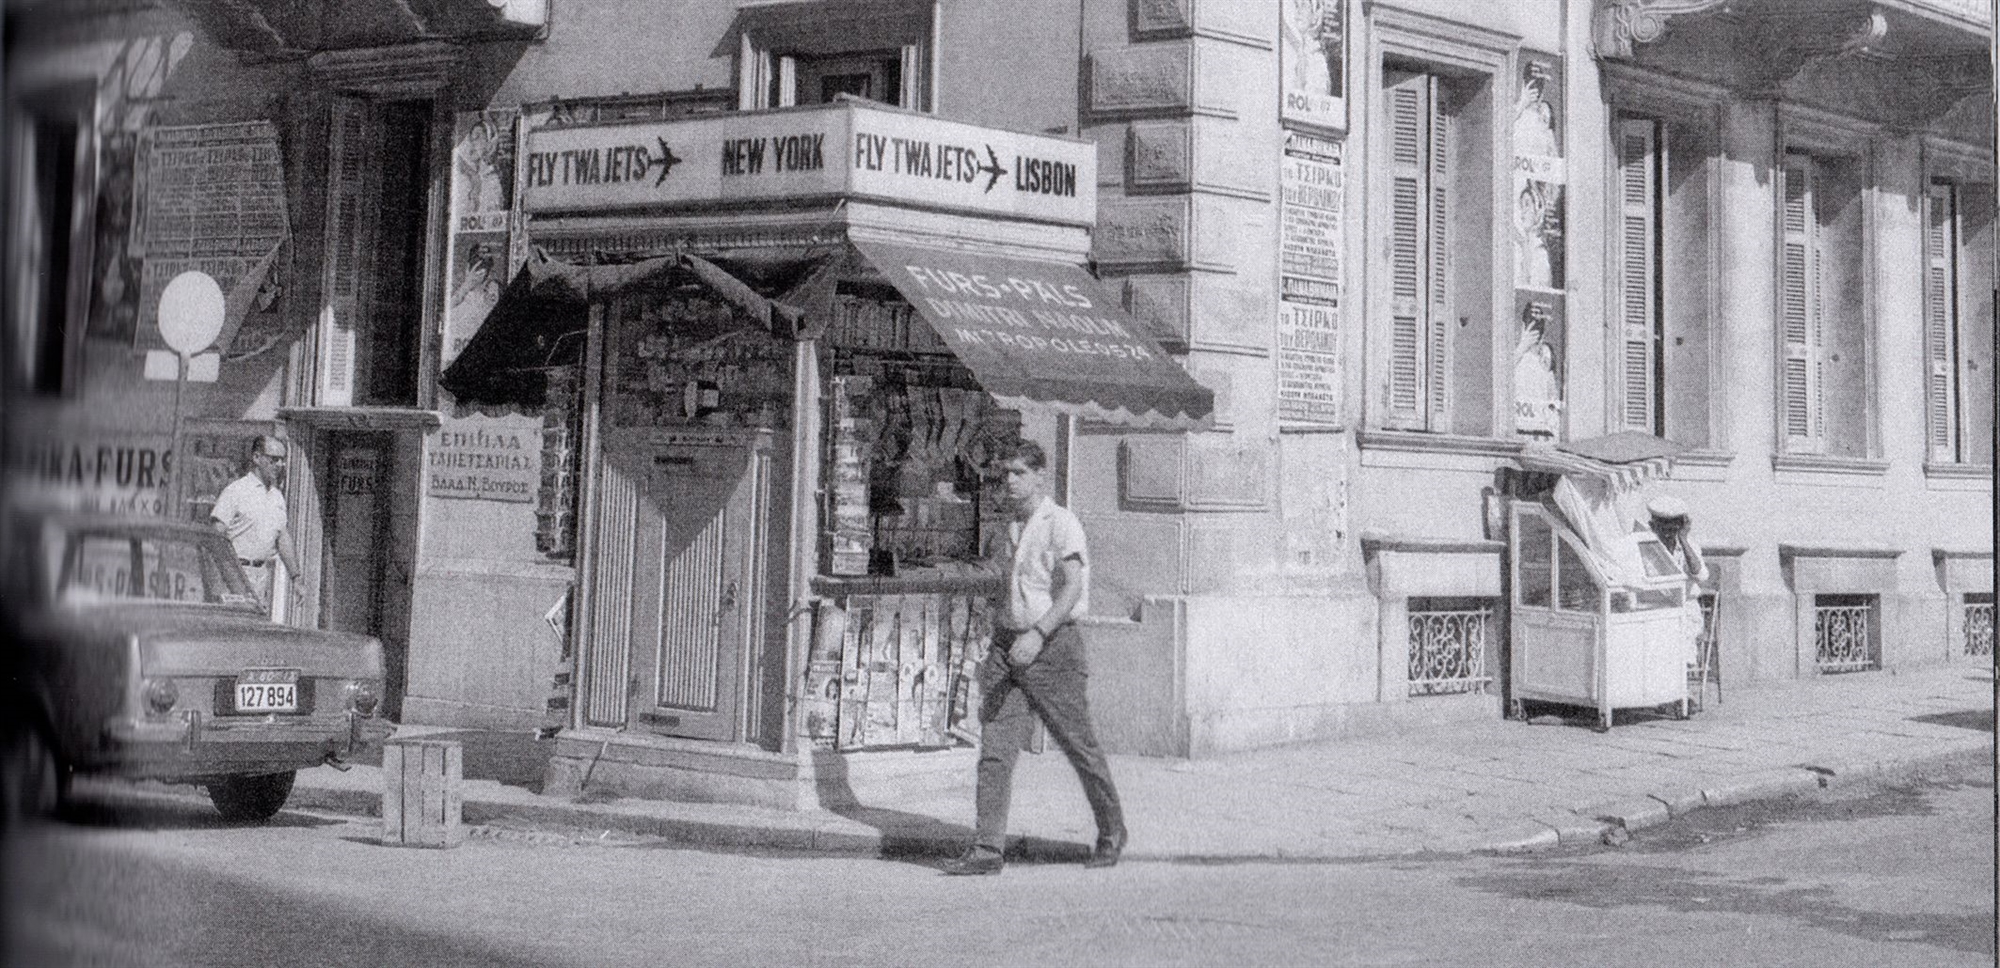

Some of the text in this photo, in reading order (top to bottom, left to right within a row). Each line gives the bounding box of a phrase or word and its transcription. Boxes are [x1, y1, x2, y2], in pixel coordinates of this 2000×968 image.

[527, 132, 825, 188] FLY TWA JETS NEW YORK
[855, 132, 1076, 198] FLY TWA JETS LISBON
[241, 686, 293, 708] 127 894
